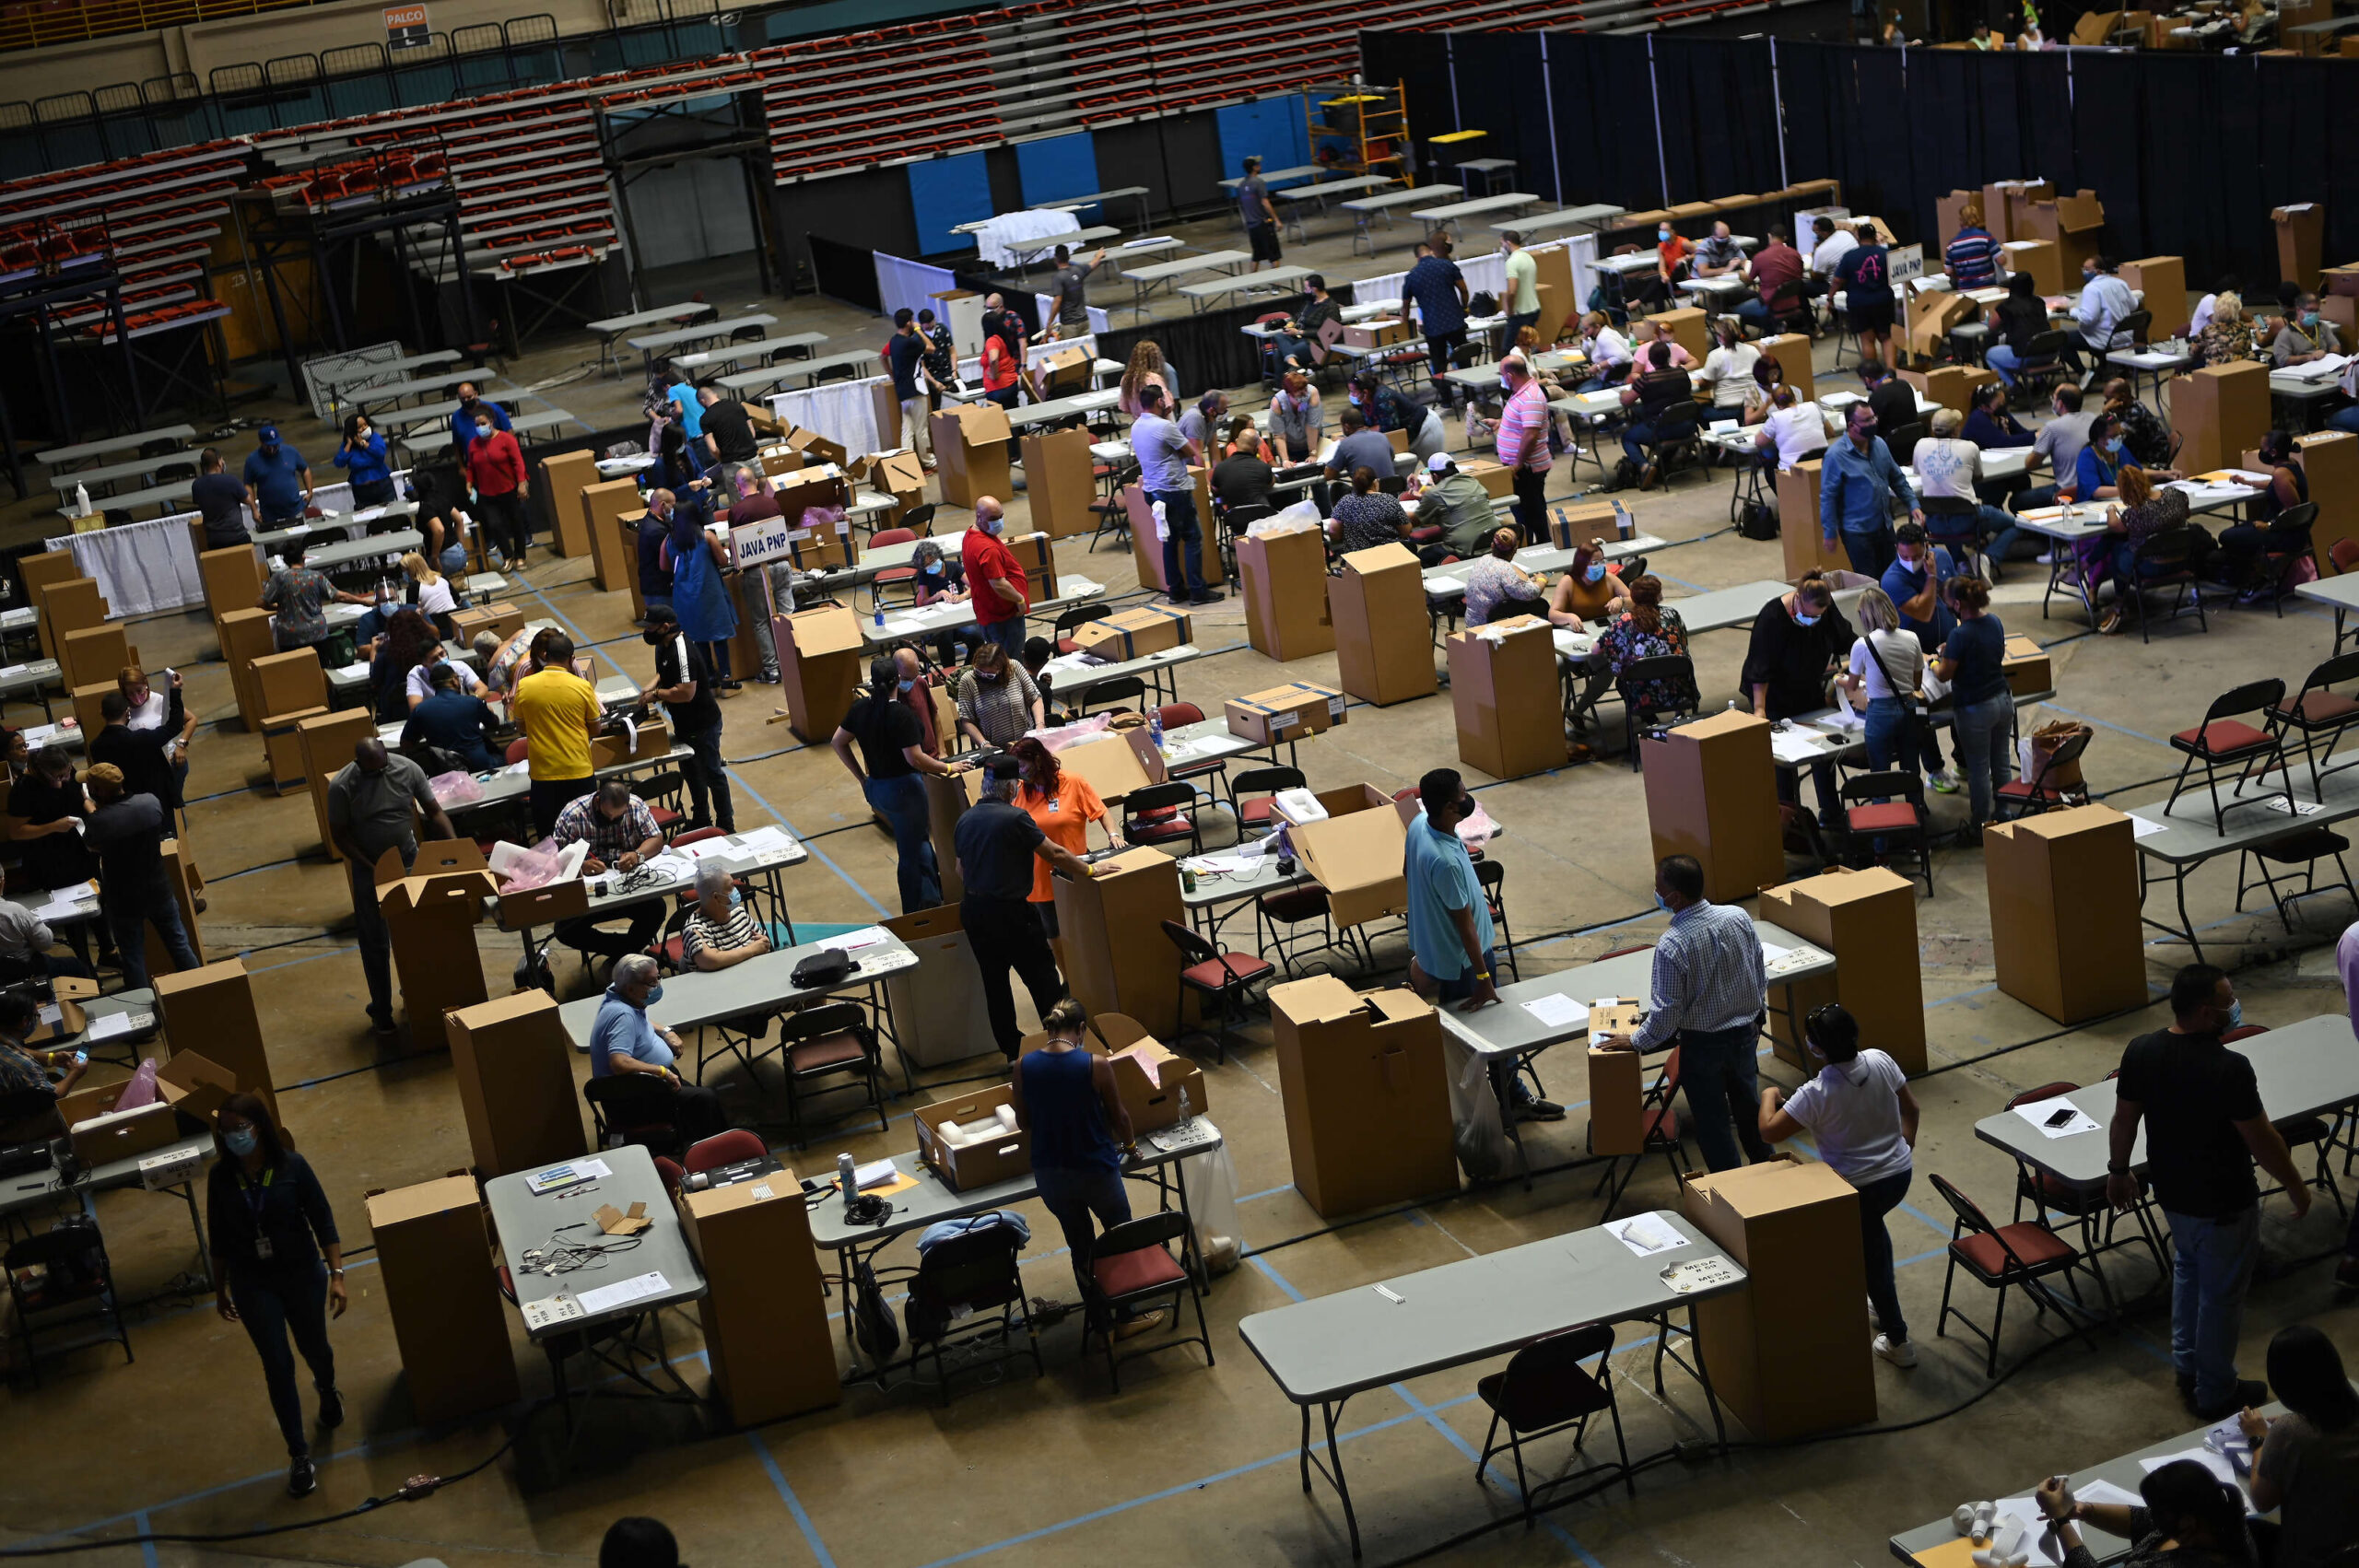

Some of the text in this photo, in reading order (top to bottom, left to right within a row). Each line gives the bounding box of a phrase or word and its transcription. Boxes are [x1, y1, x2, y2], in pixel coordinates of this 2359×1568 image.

[387, 10, 424, 26] PALCO
[403, 28, 416, 45] L
[1892, 258, 1921, 278] JAVA PNP
[740, 538, 767, 559] JAVA
[766, 532, 786, 551] PNP
[167, 1162, 194, 1174] MESA
[1684, 1259, 1717, 1271] MESA
[1697, 1270, 1731, 1282] MESA
[566, 1303, 576, 1316] MESA
[540, 1310, 550, 1323] MESA
